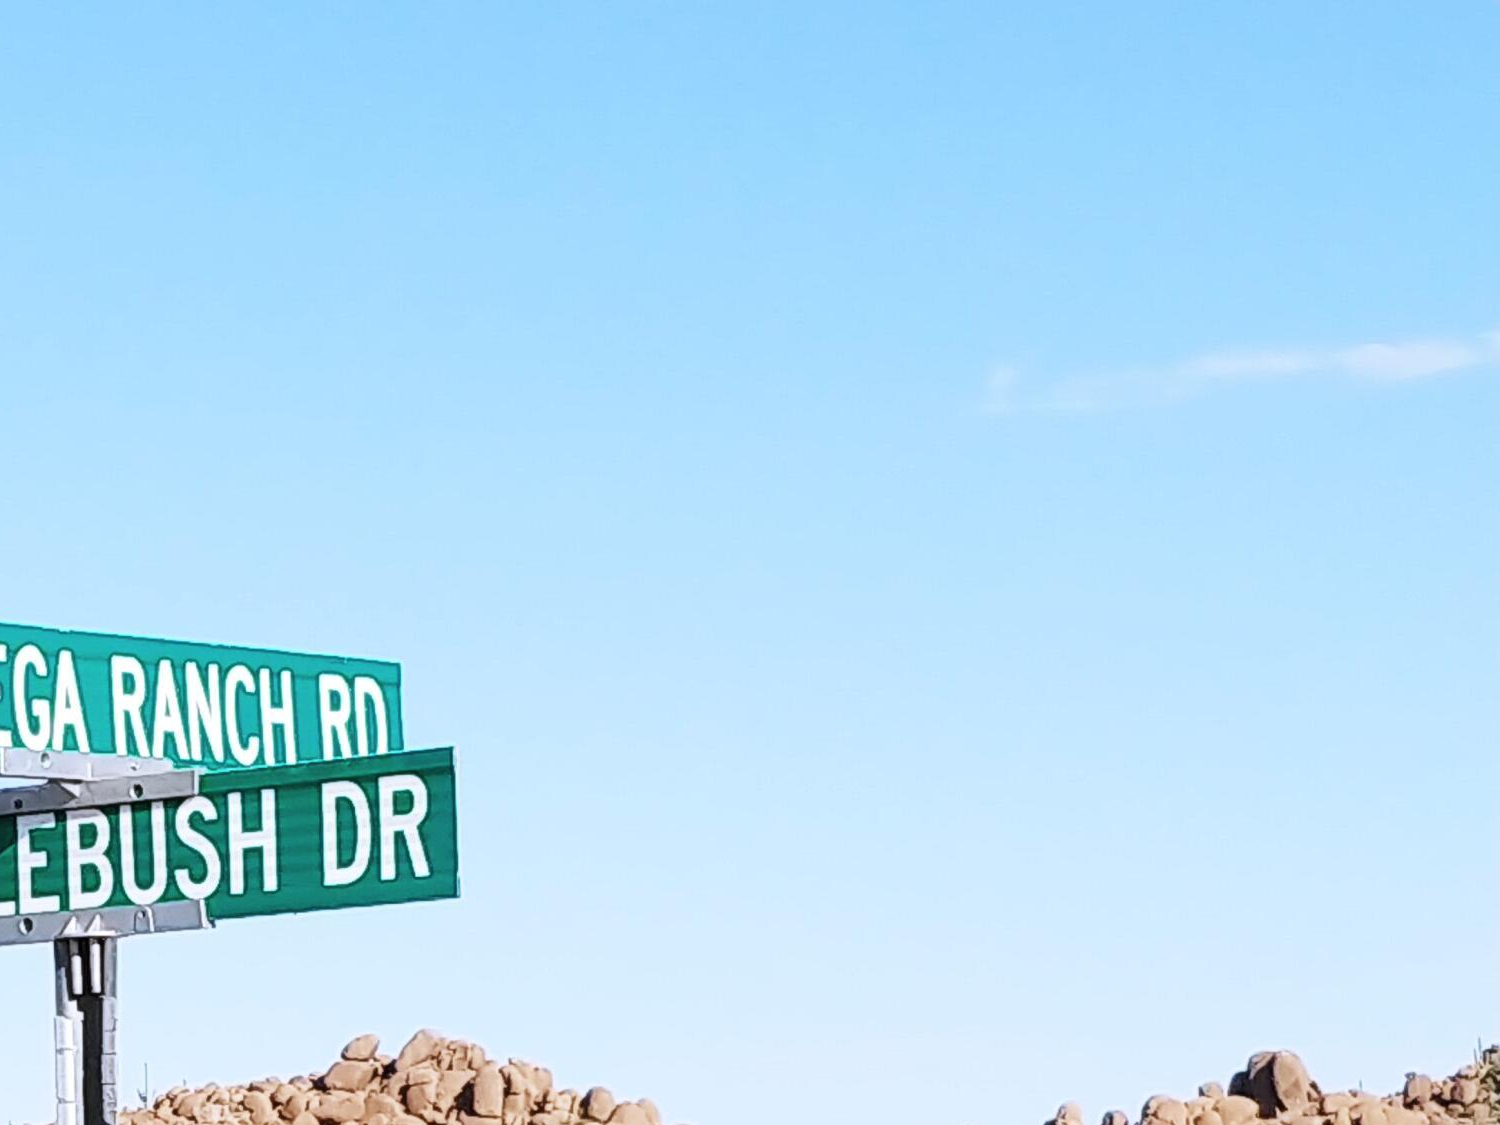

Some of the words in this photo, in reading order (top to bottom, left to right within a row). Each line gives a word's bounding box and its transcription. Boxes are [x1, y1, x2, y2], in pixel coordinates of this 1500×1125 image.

[110, 654, 294, 767] RANCH
[318, 673, 388, 762] RD
[320, 774, 431, 886] DR
